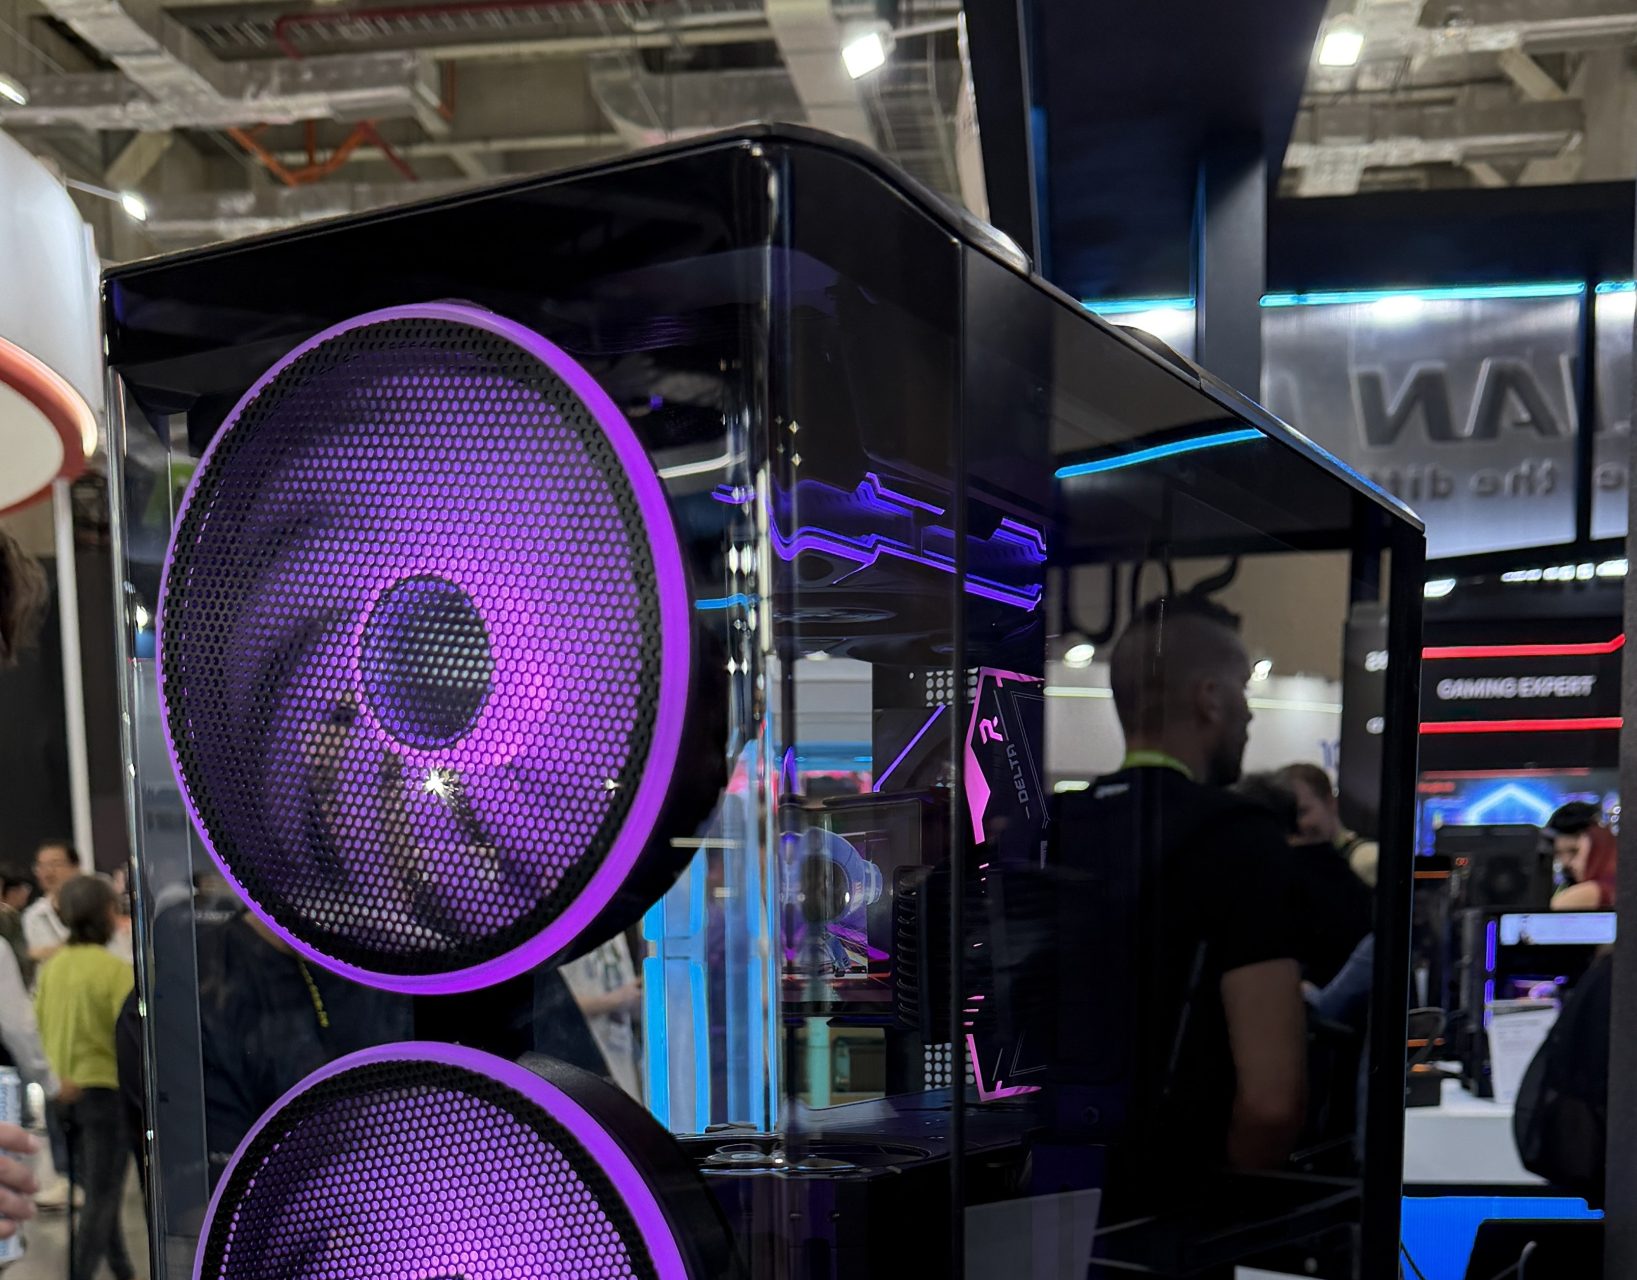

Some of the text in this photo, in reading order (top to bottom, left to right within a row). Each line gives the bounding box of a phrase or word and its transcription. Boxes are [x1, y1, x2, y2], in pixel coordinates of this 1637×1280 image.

[1437, 674, 1597, 700] GAMING EXPERT
[1006, 743, 1029, 804] DELTA
